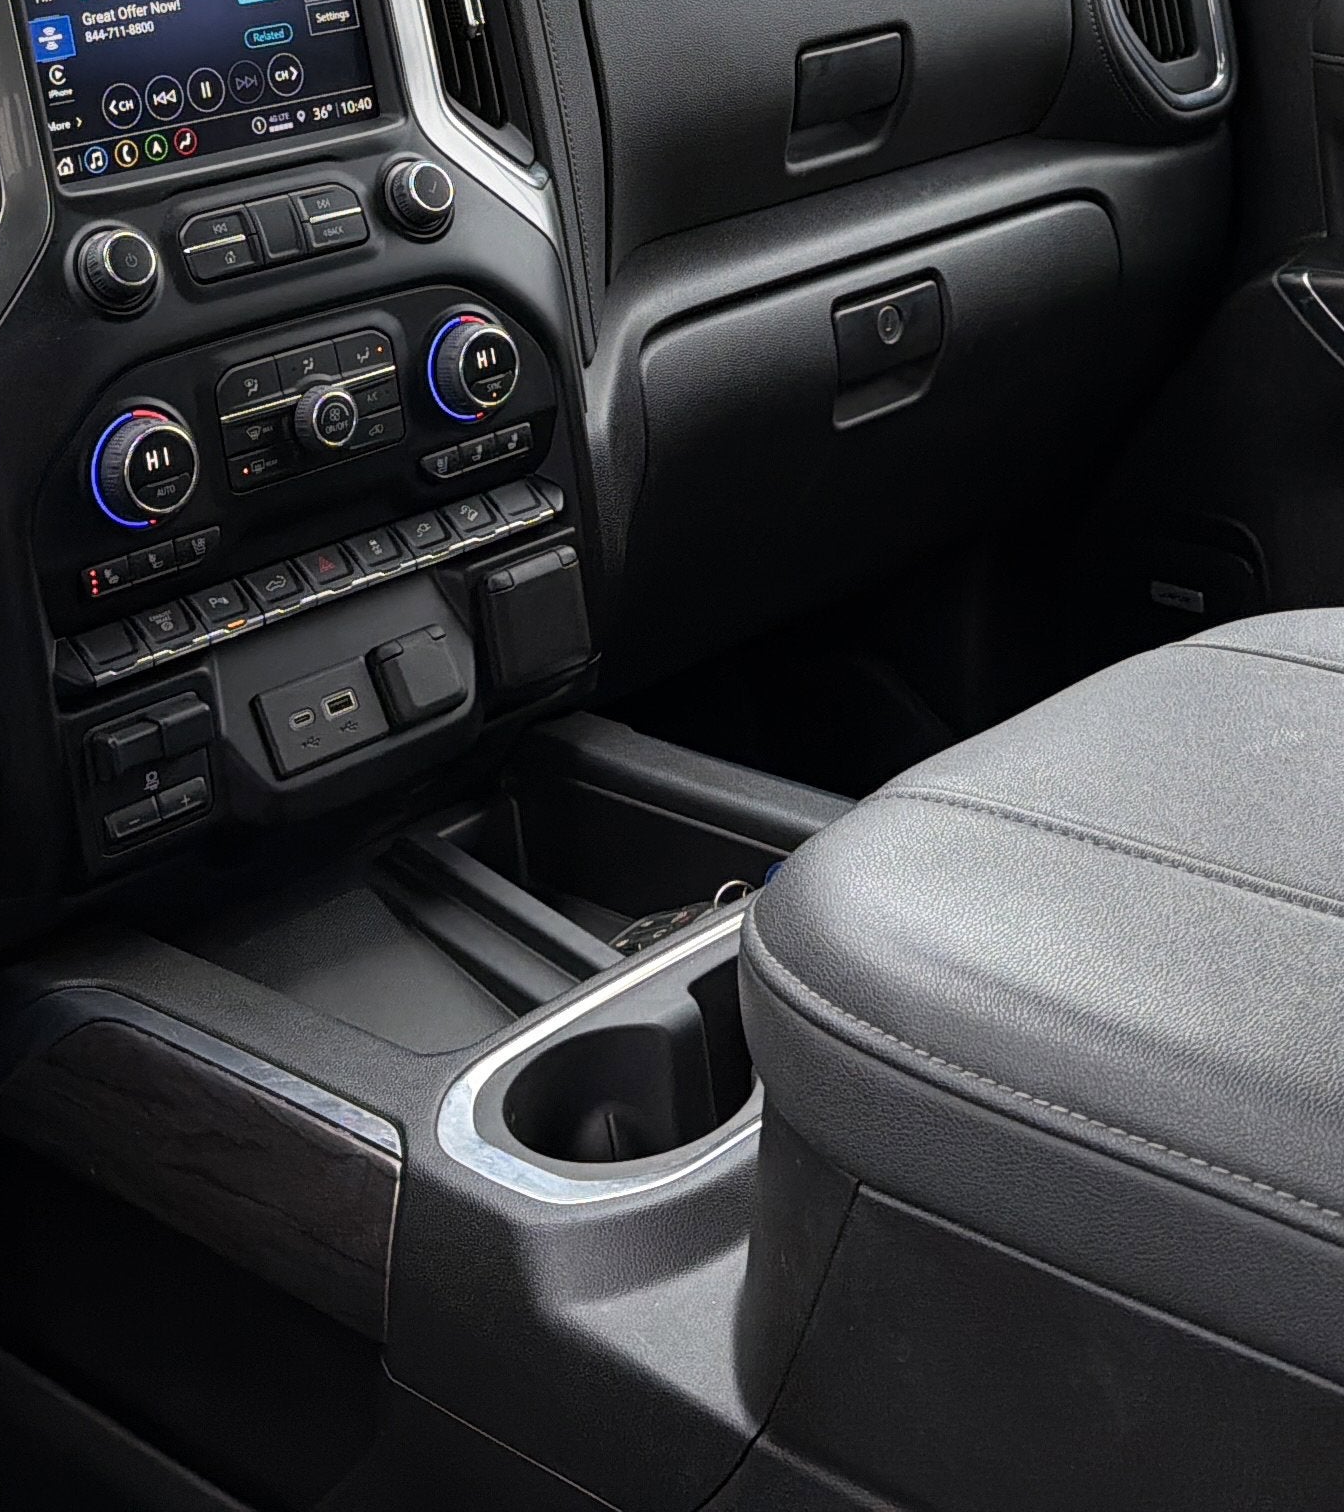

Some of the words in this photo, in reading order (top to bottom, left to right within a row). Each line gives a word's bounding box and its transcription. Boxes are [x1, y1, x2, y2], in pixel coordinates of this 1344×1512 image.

[82, 10, 116, 26] Great
[117, 4, 148, 21] Offer
[315, 10, 351, 24] Settings
[84, 20, 155, 43] 844-711-8800
[253, 28, 285, 43] Related
[274, 69, 290, 82] CH
[118, 98, 135, 112] CH
[341, 97, 373, 115] 10:40
[476, 347, 497, 370] HI
[325, 420, 350, 435] ON/OFF
[146, 446, 170, 472] HI
[156, 484, 176, 498] AUTO
